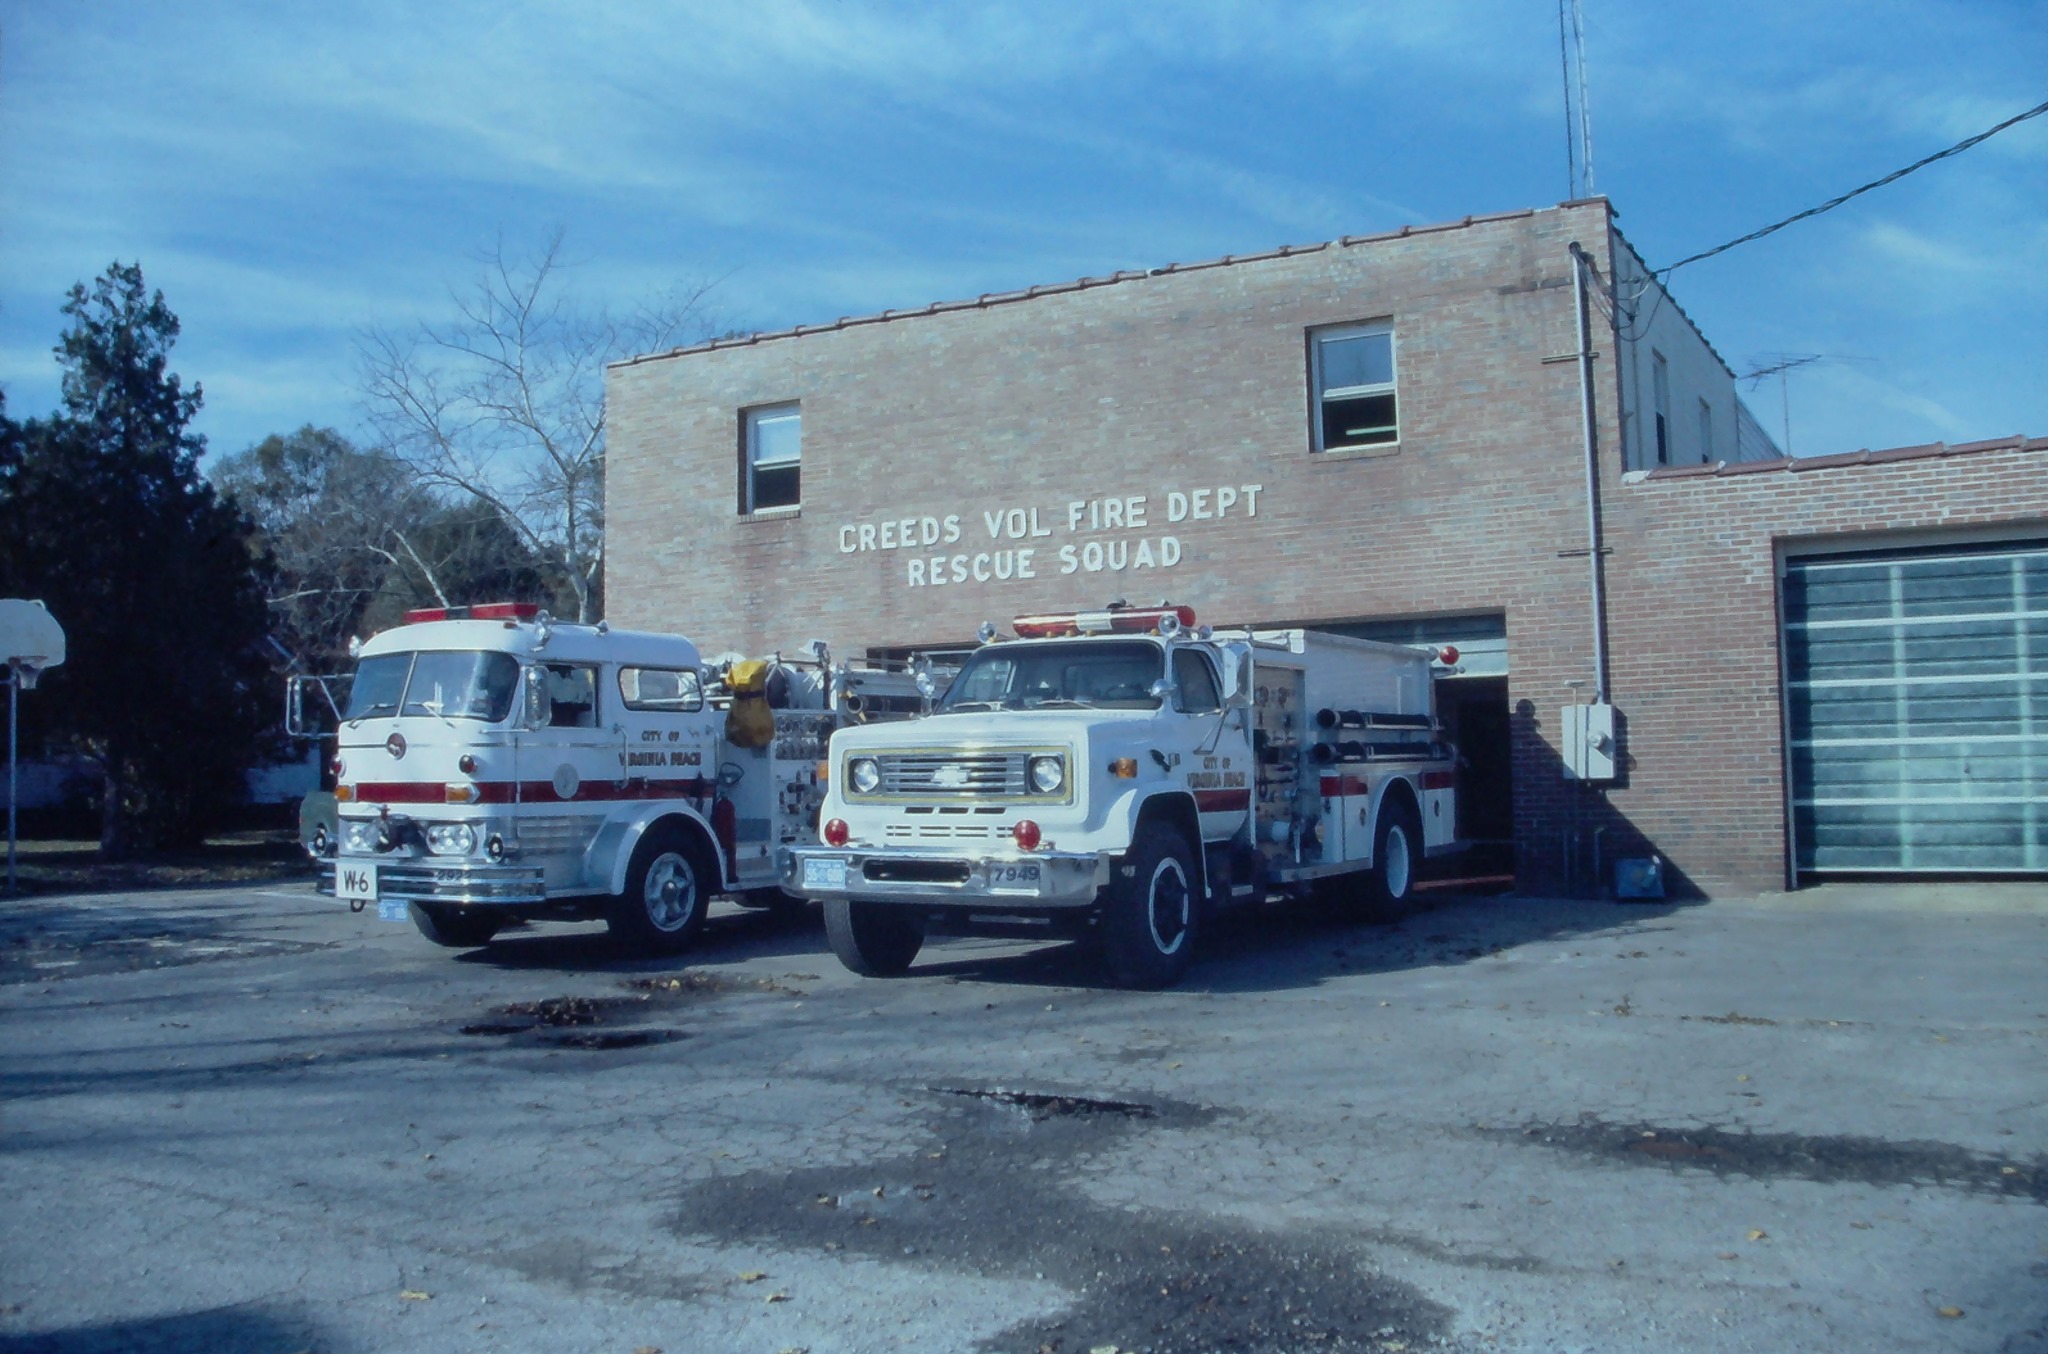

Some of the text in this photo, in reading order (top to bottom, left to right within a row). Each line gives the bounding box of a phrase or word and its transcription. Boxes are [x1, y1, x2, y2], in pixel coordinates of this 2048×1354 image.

[839, 484, 1263, 554] CREEDS VOL FIRE DEPT
[908, 536, 1181, 588] RESCUE SQUAD
[641, 730, 662, 742] CITY
[344, 870, 369, 893] W-6
[994, 866, 1040, 881] 7949
